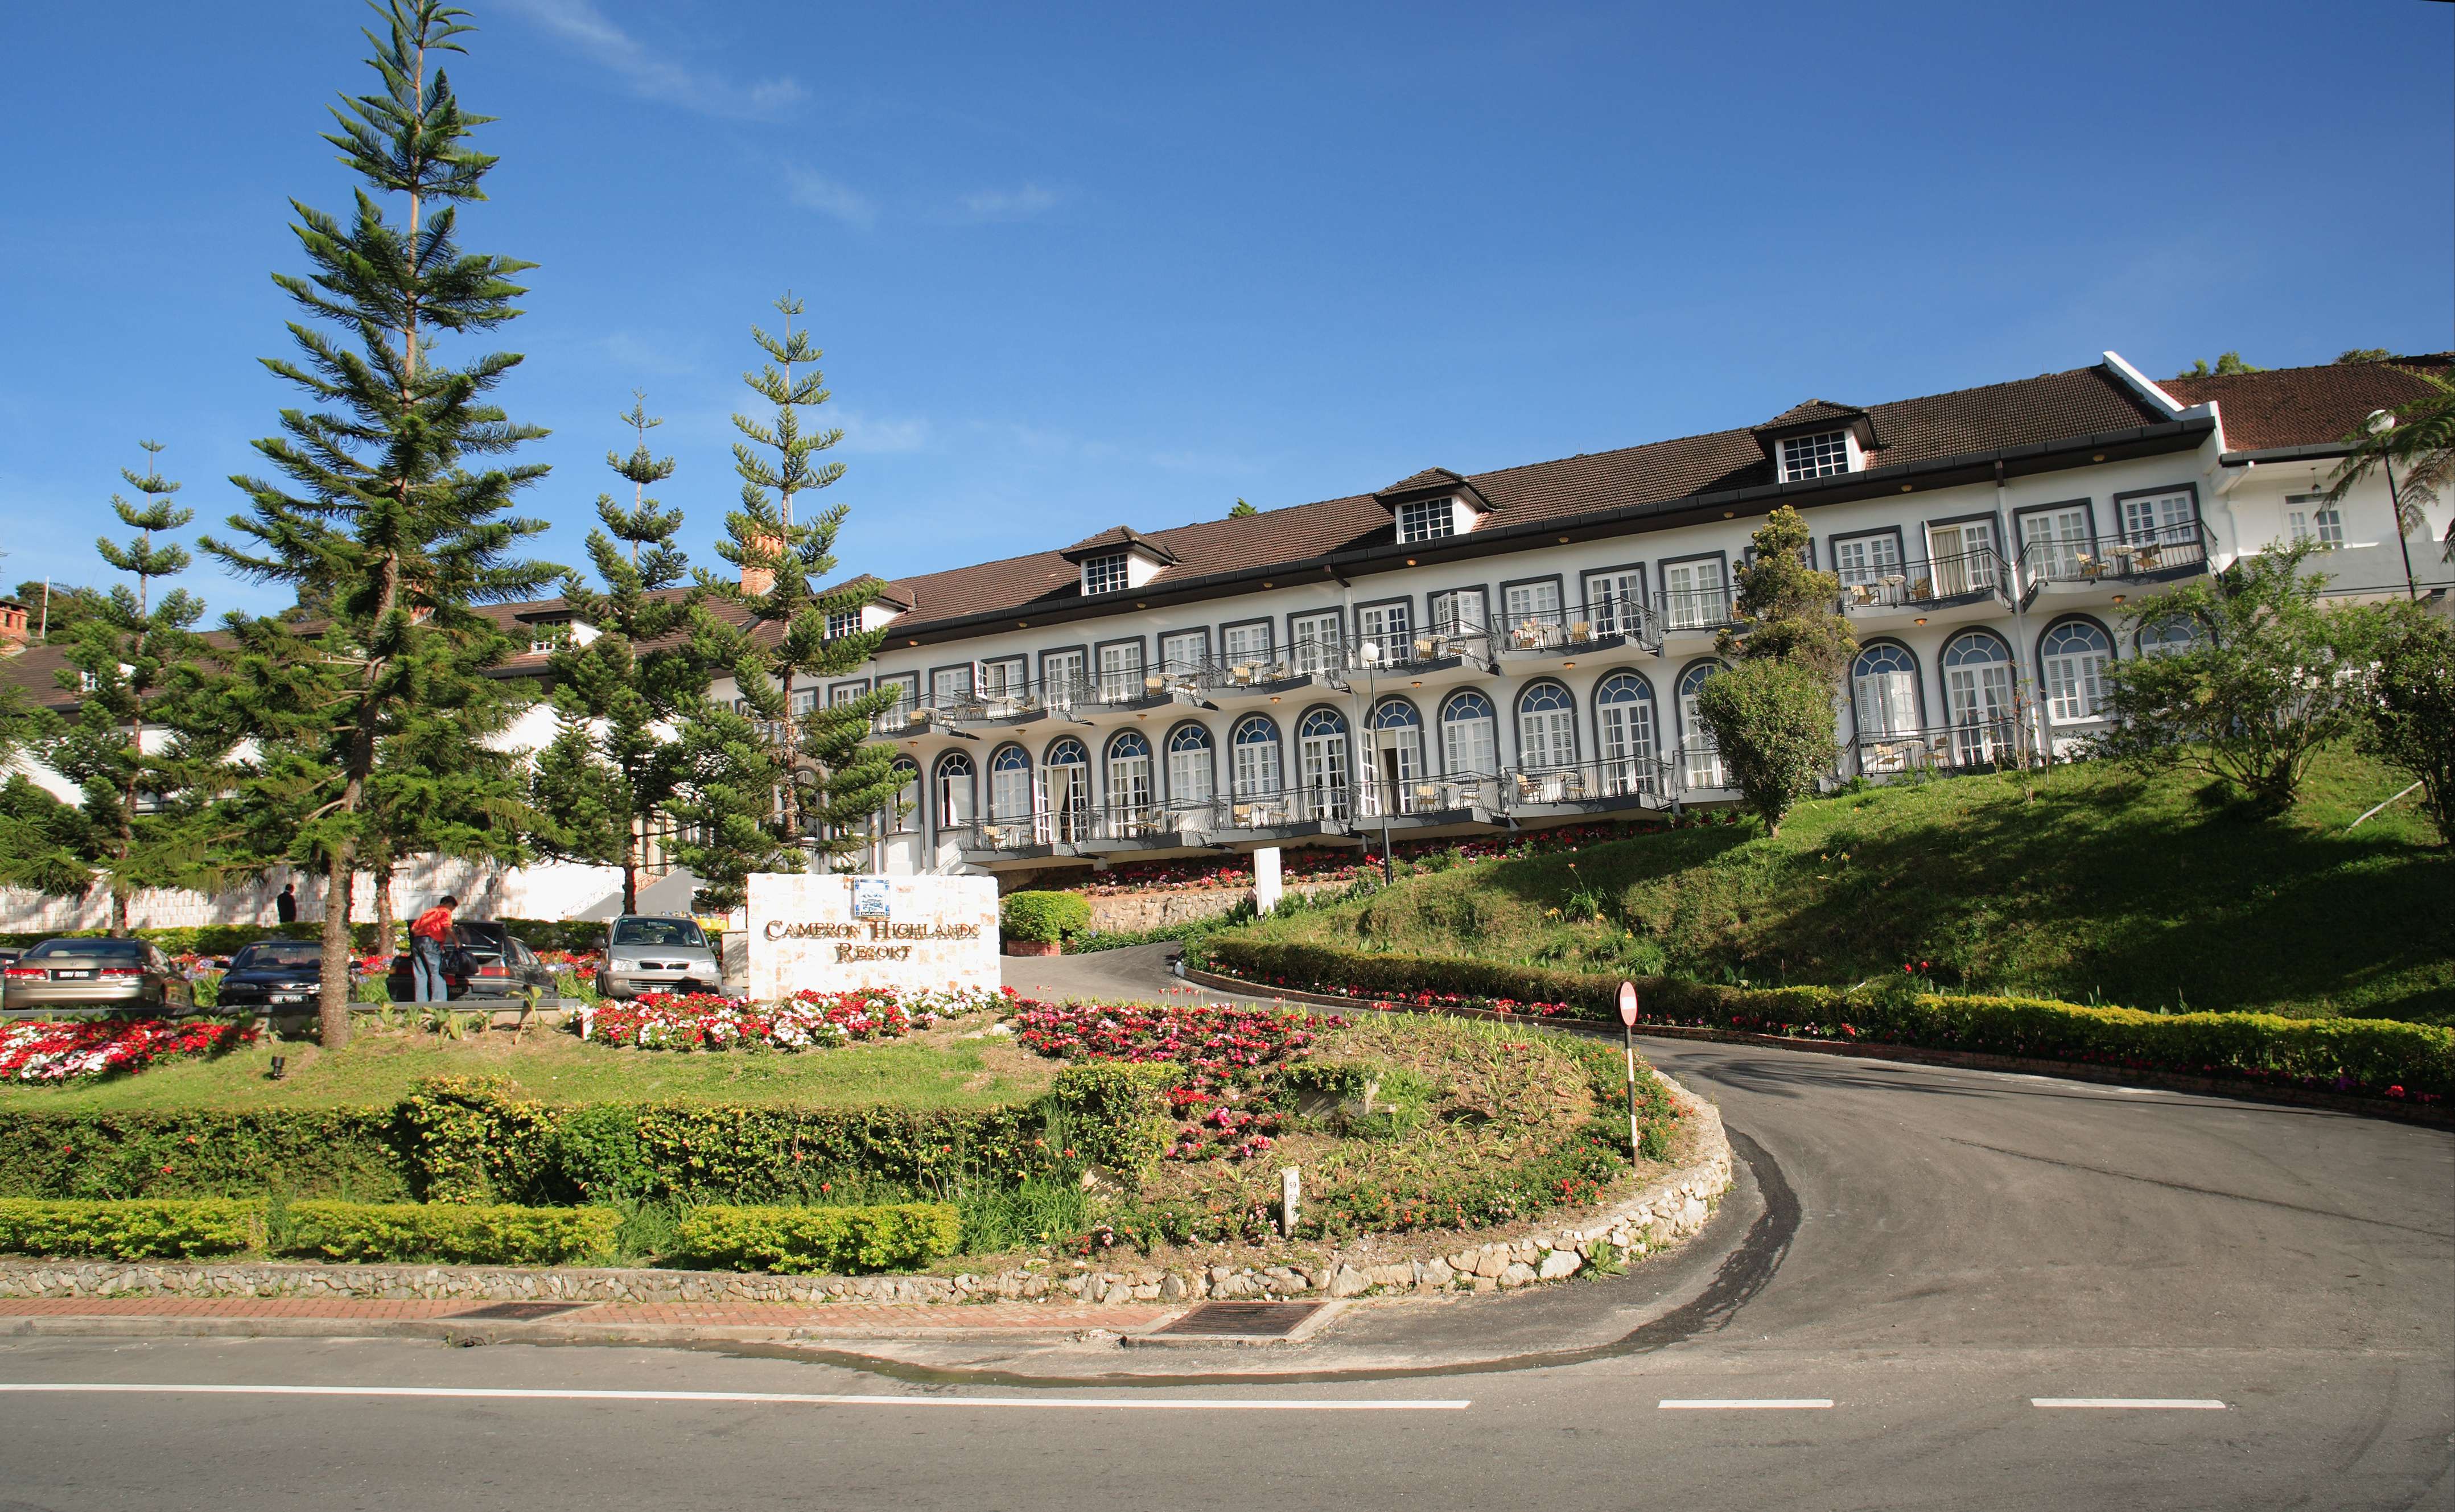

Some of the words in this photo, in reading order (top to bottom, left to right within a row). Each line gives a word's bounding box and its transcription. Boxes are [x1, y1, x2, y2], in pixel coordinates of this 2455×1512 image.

[766, 920, 862, 938] CAMERON
[873, 920, 980, 939] HIGHLANDS
[837, 942, 912, 961] RESORT
